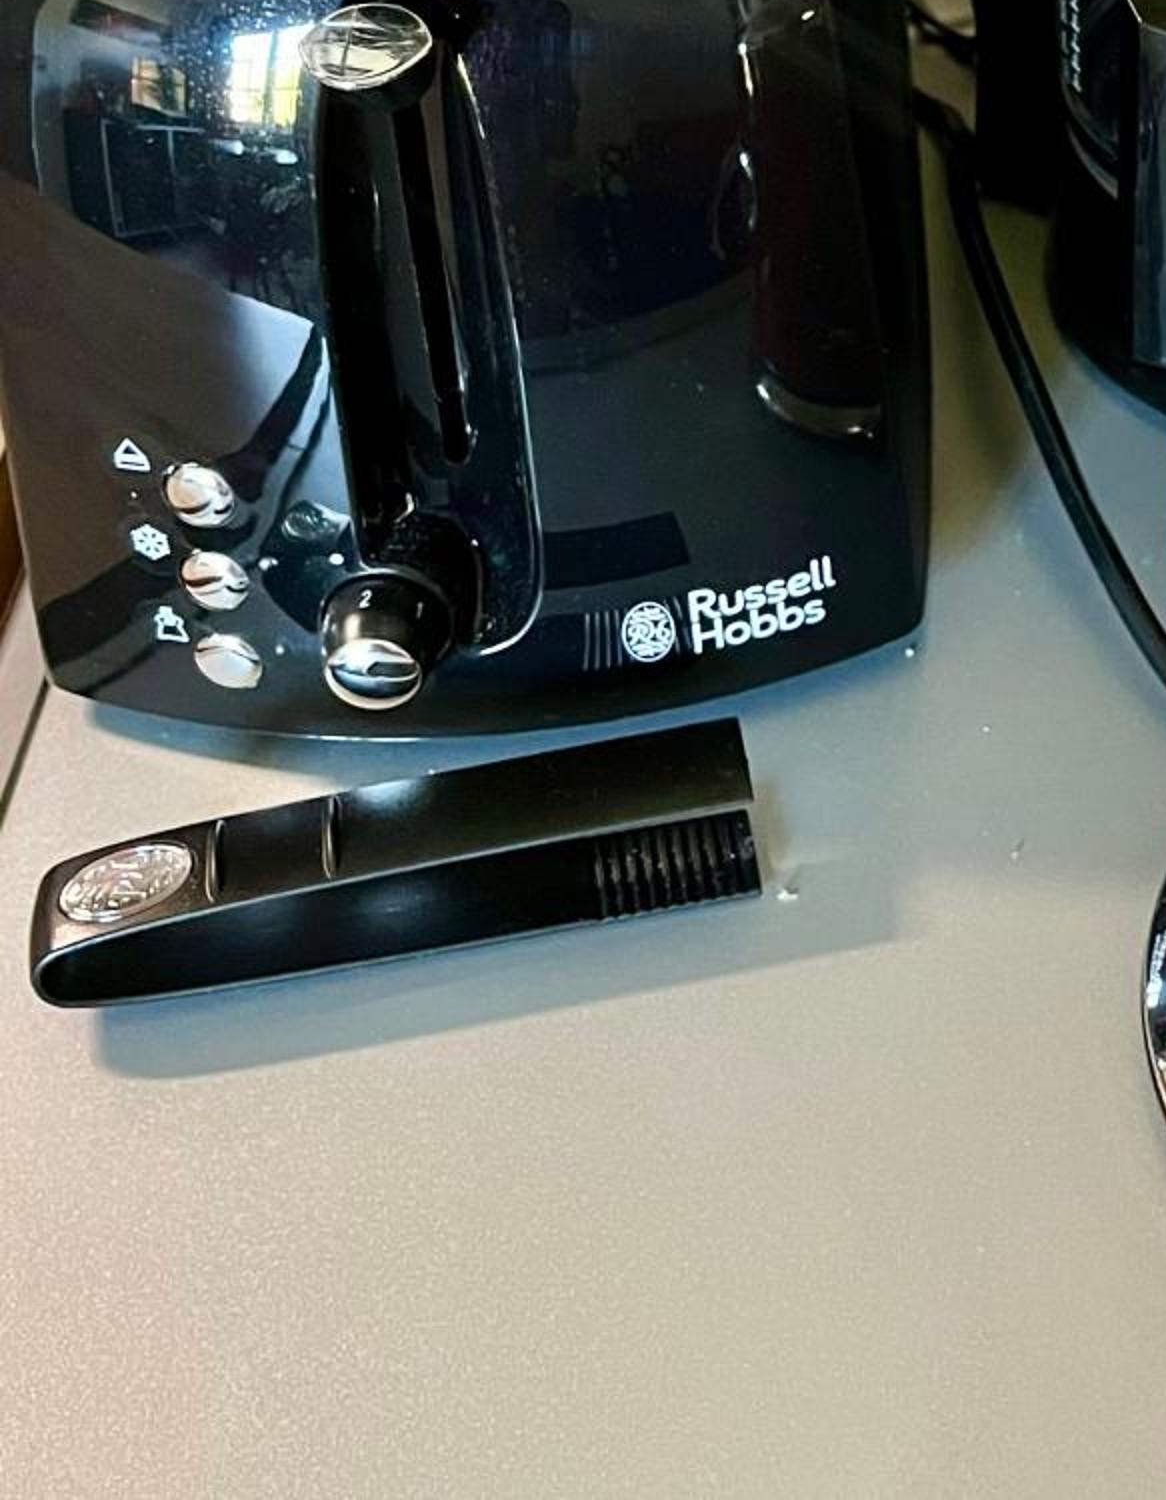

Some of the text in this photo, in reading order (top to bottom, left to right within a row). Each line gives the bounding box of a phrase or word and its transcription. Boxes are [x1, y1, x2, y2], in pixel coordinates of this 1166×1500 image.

[359, 589, 372, 609] 2
[688, 555, 836, 623] Russell
[691, 599, 827, 655] Hobbs
